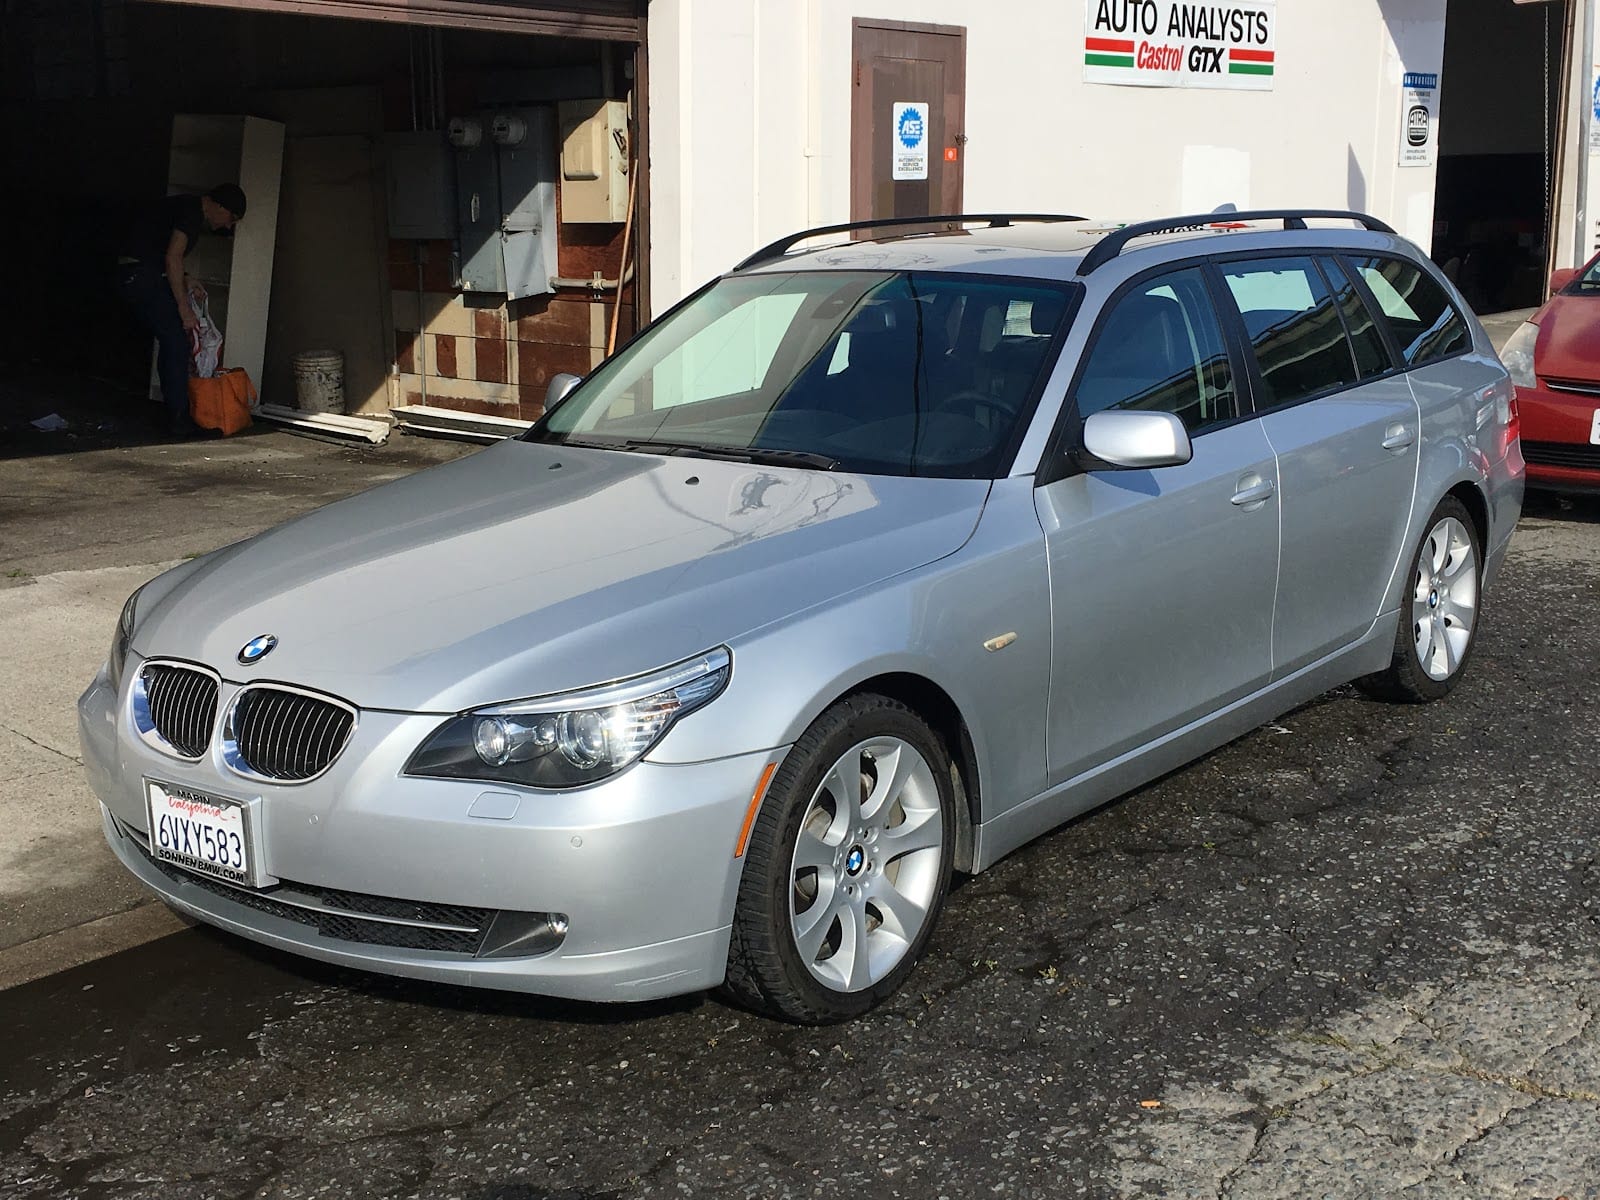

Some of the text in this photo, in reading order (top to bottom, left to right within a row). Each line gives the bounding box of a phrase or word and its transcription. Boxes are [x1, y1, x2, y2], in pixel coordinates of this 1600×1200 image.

[1095, 0, 1268, 45] AUTO ANALYSTS
[1137, 40, 1225, 73] Castrol GTX
[901, 120, 921, 135] ASE
[160, 813, 242, 869] 6VXY583
